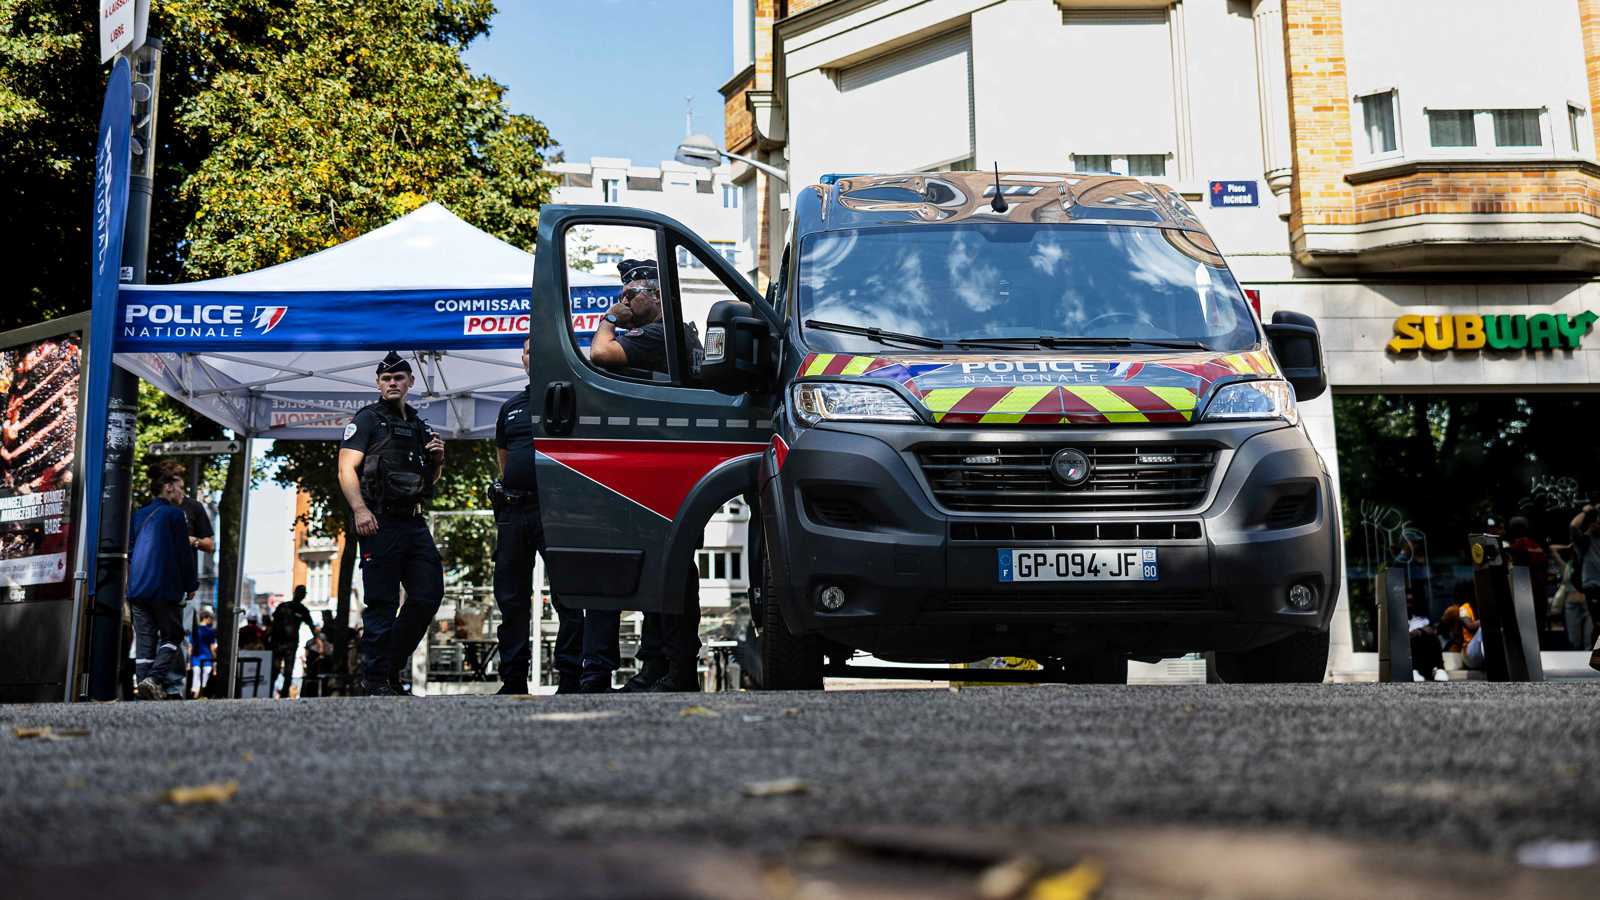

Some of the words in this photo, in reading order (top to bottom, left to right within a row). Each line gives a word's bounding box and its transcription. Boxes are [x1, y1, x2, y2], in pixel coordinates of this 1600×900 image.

[434, 299, 530, 312] COMMISSAR
[125, 304, 243, 324] POLICE
[467, 316, 530, 332] POLIC
[124, 327, 243, 338] NATIONALE
[1387, 310, 1599, 355] SUBWAY
[961, 361, 1098, 374] POLICE
[963, 374, 1100, 384] NATIONALE
[1018, 552, 1137, 578] GP-094-JF
[1144, 565, 1157, 577] 80
[1003, 569, 1009, 577] F
